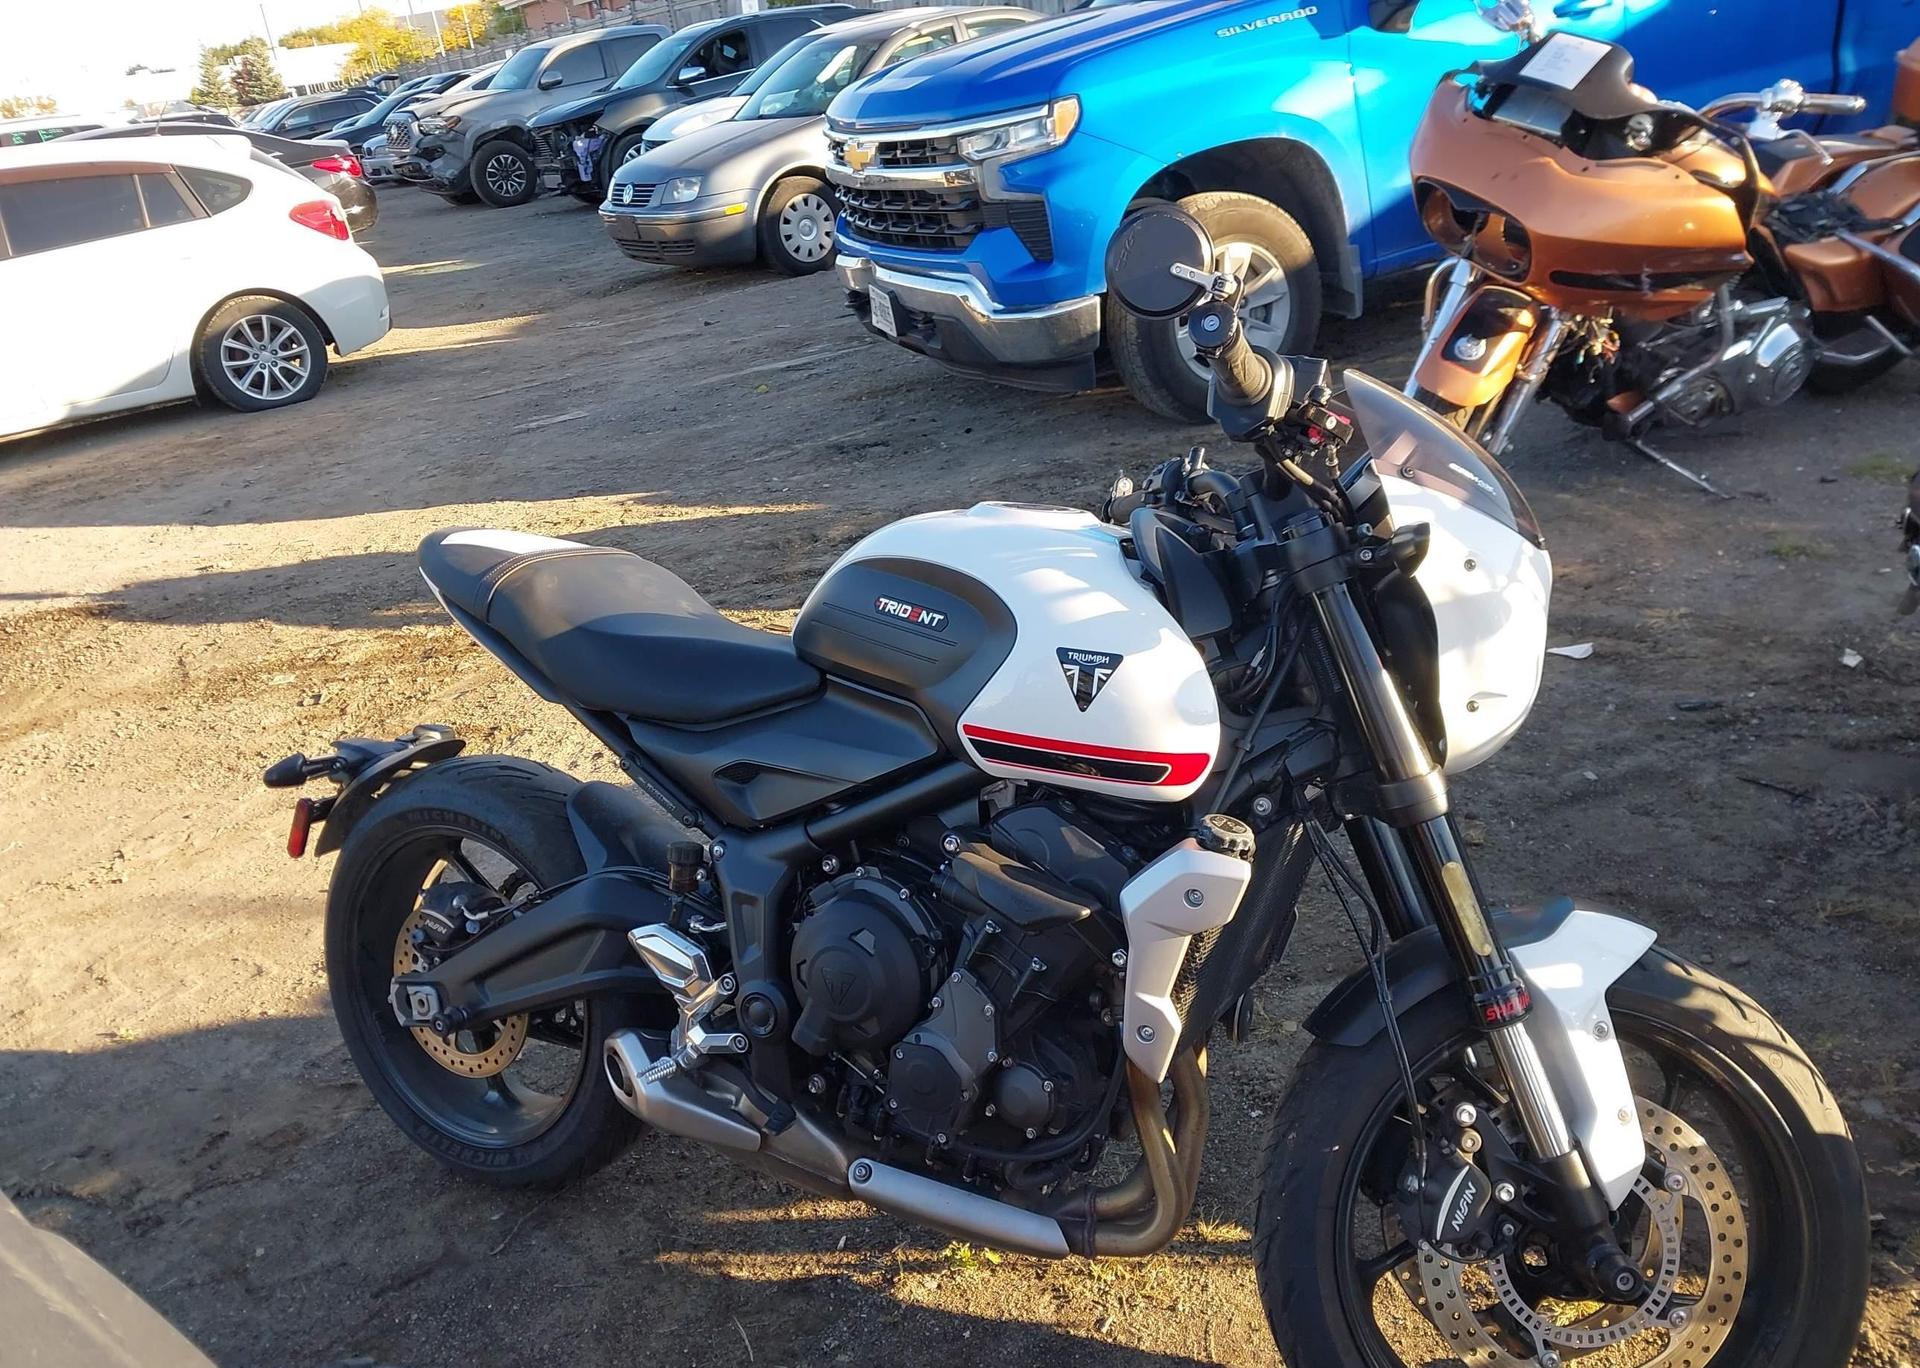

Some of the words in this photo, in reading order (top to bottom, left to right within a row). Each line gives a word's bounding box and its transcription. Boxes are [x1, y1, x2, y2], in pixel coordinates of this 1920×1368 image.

[1217, 6, 1318, 37] SILVERADO
[879, 597, 944, 627] TRIDENT
[1067, 651, 1110, 665] TRIUMPH
